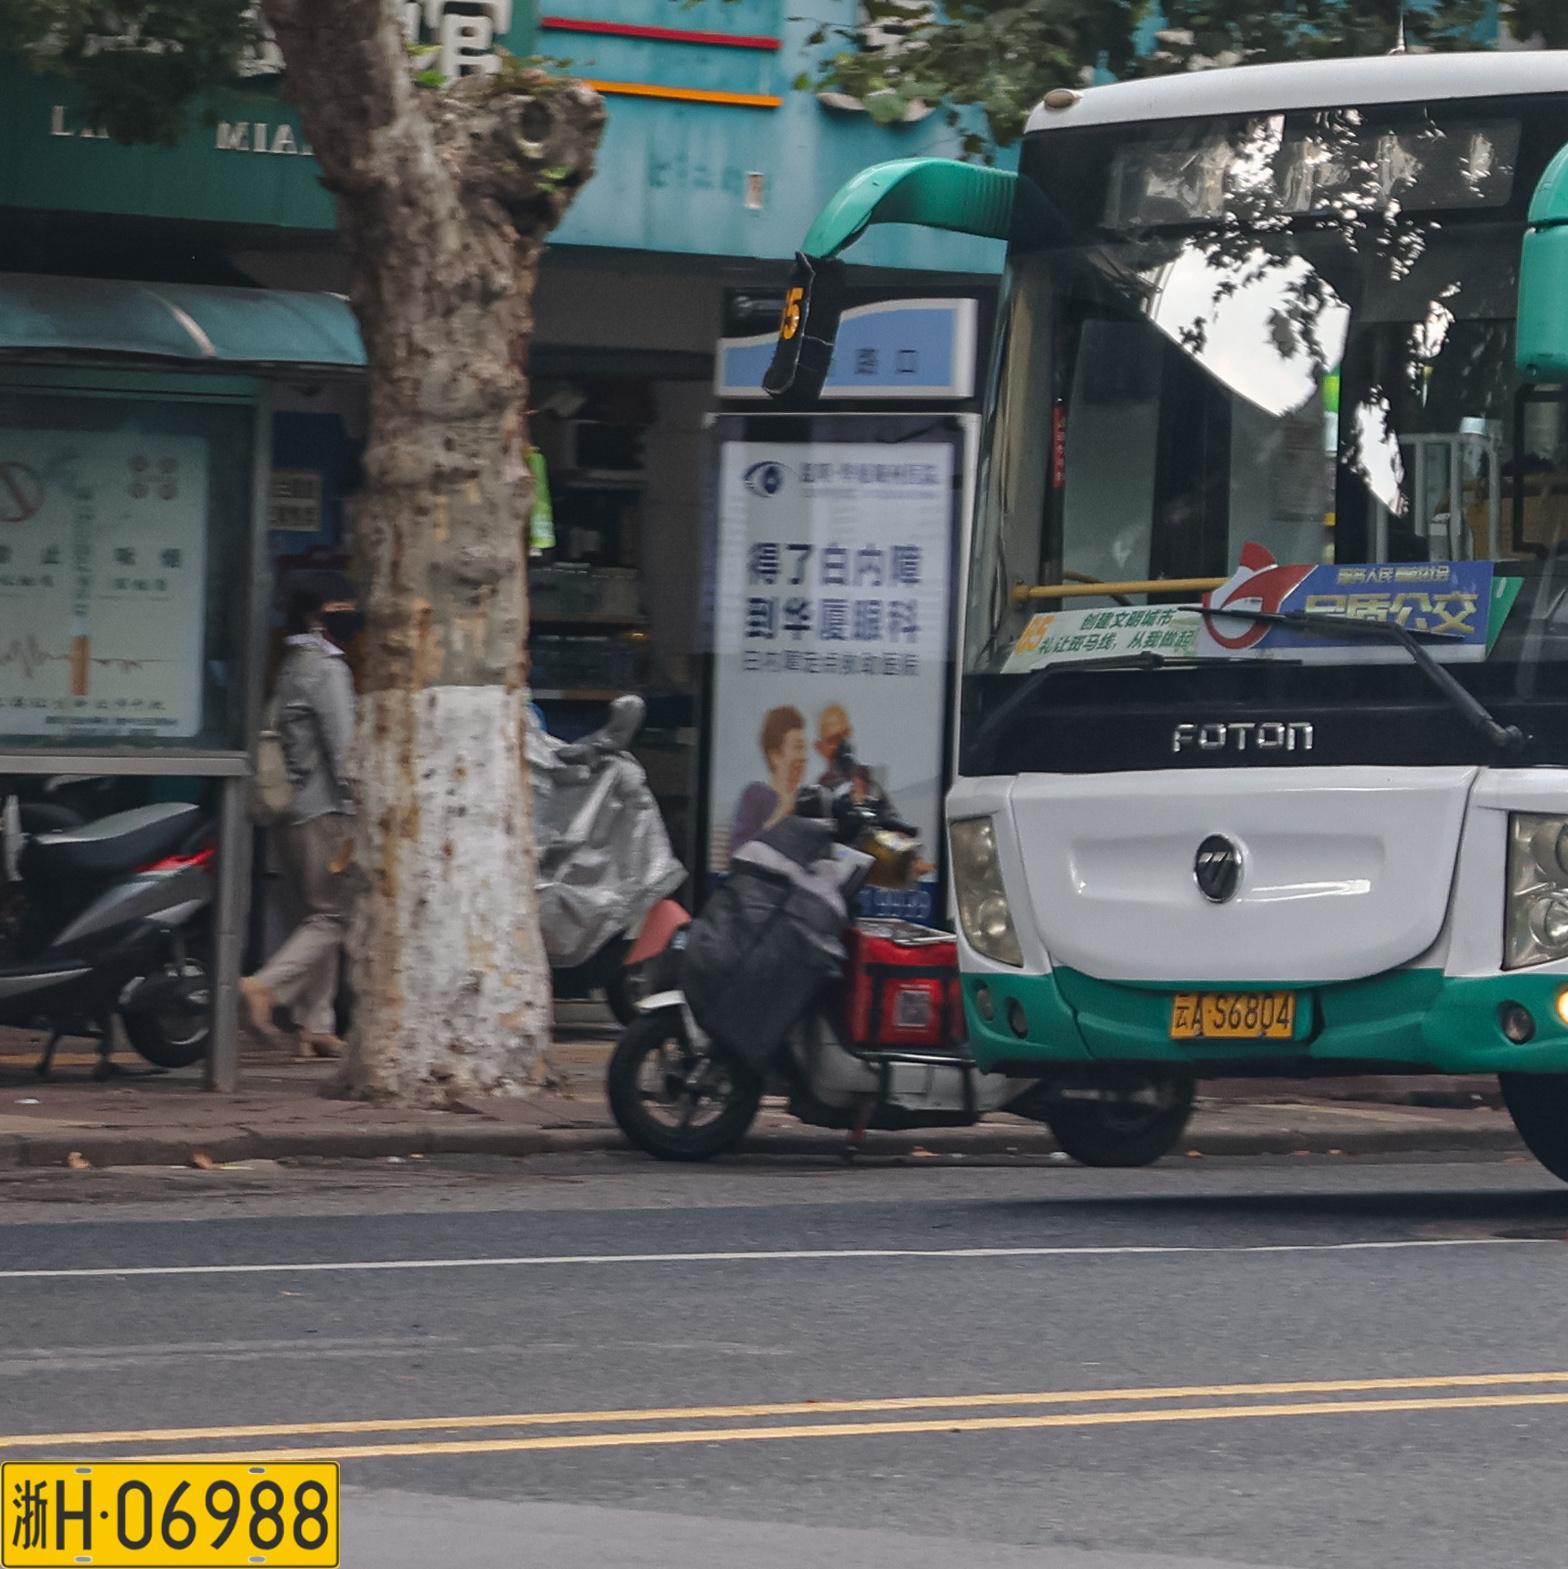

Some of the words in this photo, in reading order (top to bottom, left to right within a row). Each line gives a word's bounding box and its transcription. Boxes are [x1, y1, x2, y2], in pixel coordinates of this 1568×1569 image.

[750, 542, 922, 588] 得了白内障
[1080, 608, 1177, 631] 创建文明城市
[1173, 722, 1314, 753] FOTON
